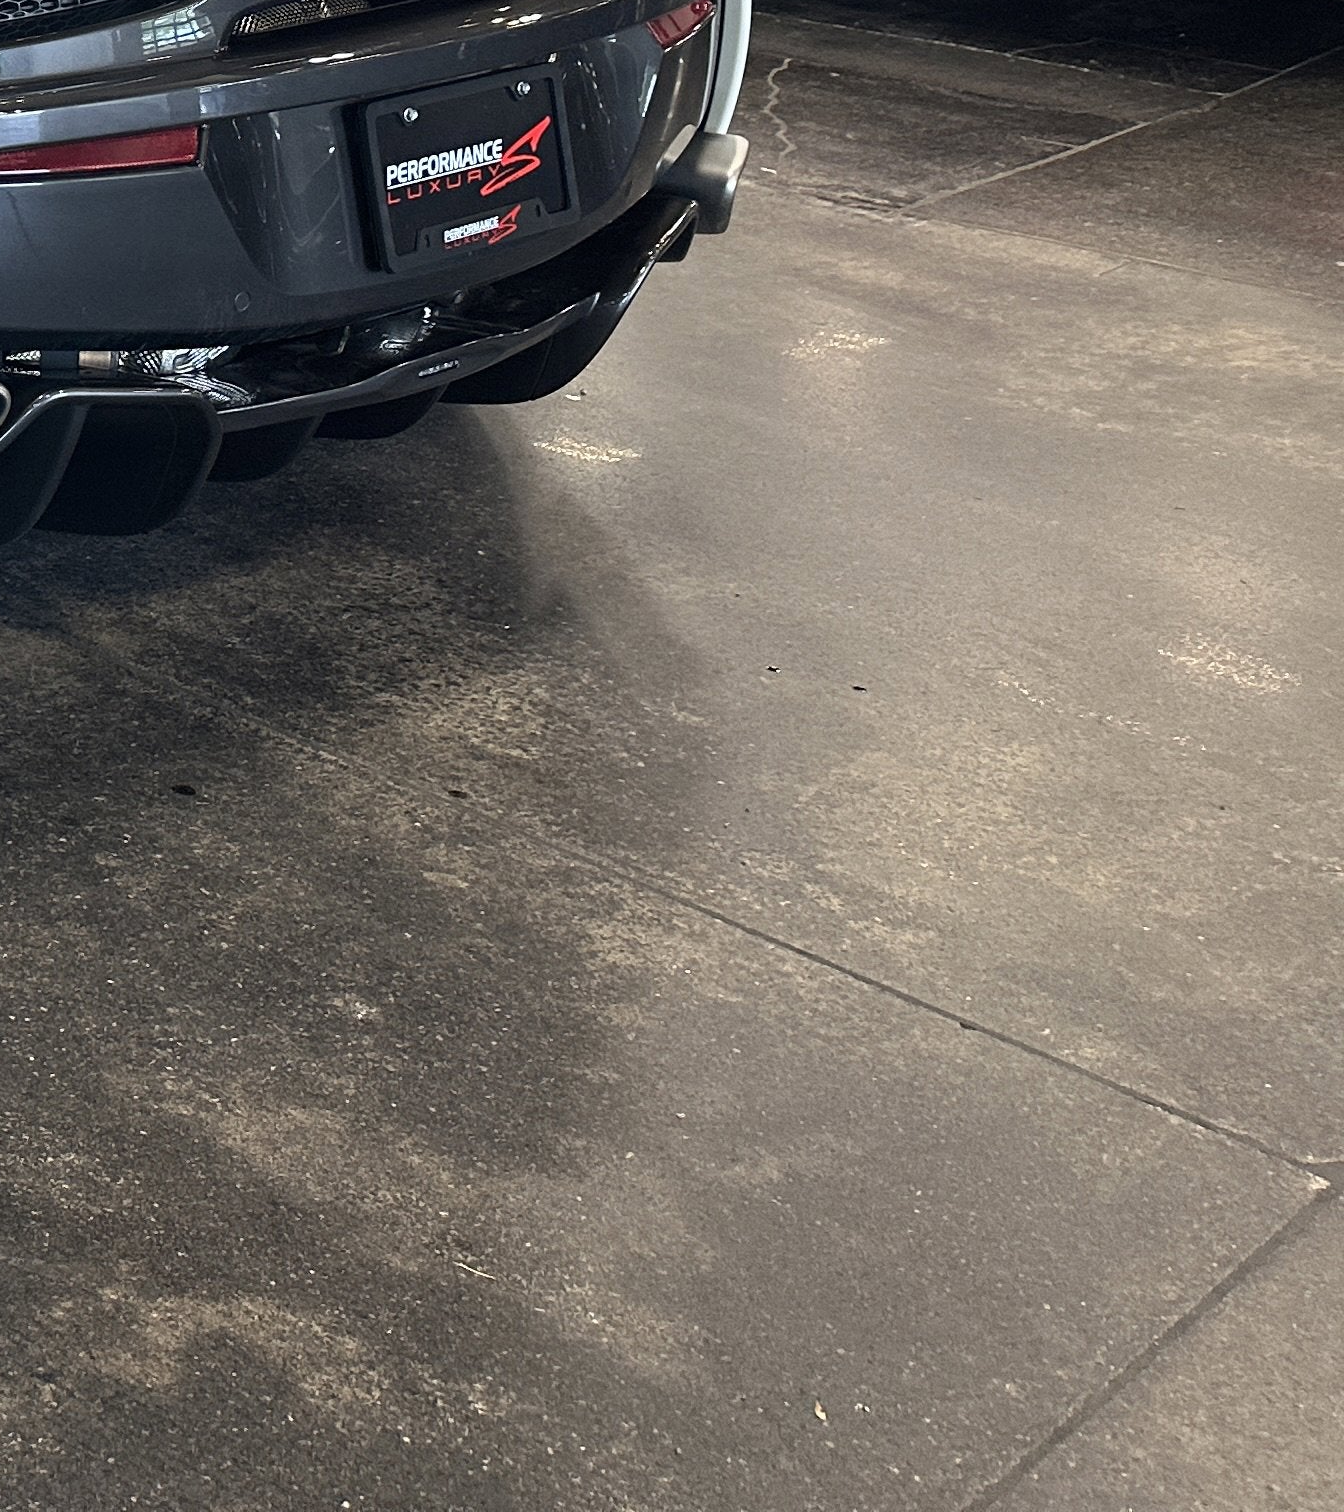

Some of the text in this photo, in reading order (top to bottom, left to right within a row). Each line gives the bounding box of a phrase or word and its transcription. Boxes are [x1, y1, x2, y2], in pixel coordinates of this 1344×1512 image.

[386, 138, 504, 187] PERFORMANCE
[387, 164, 501, 205] LUXURY
[444, 215, 500, 244] PERFORMANCE
